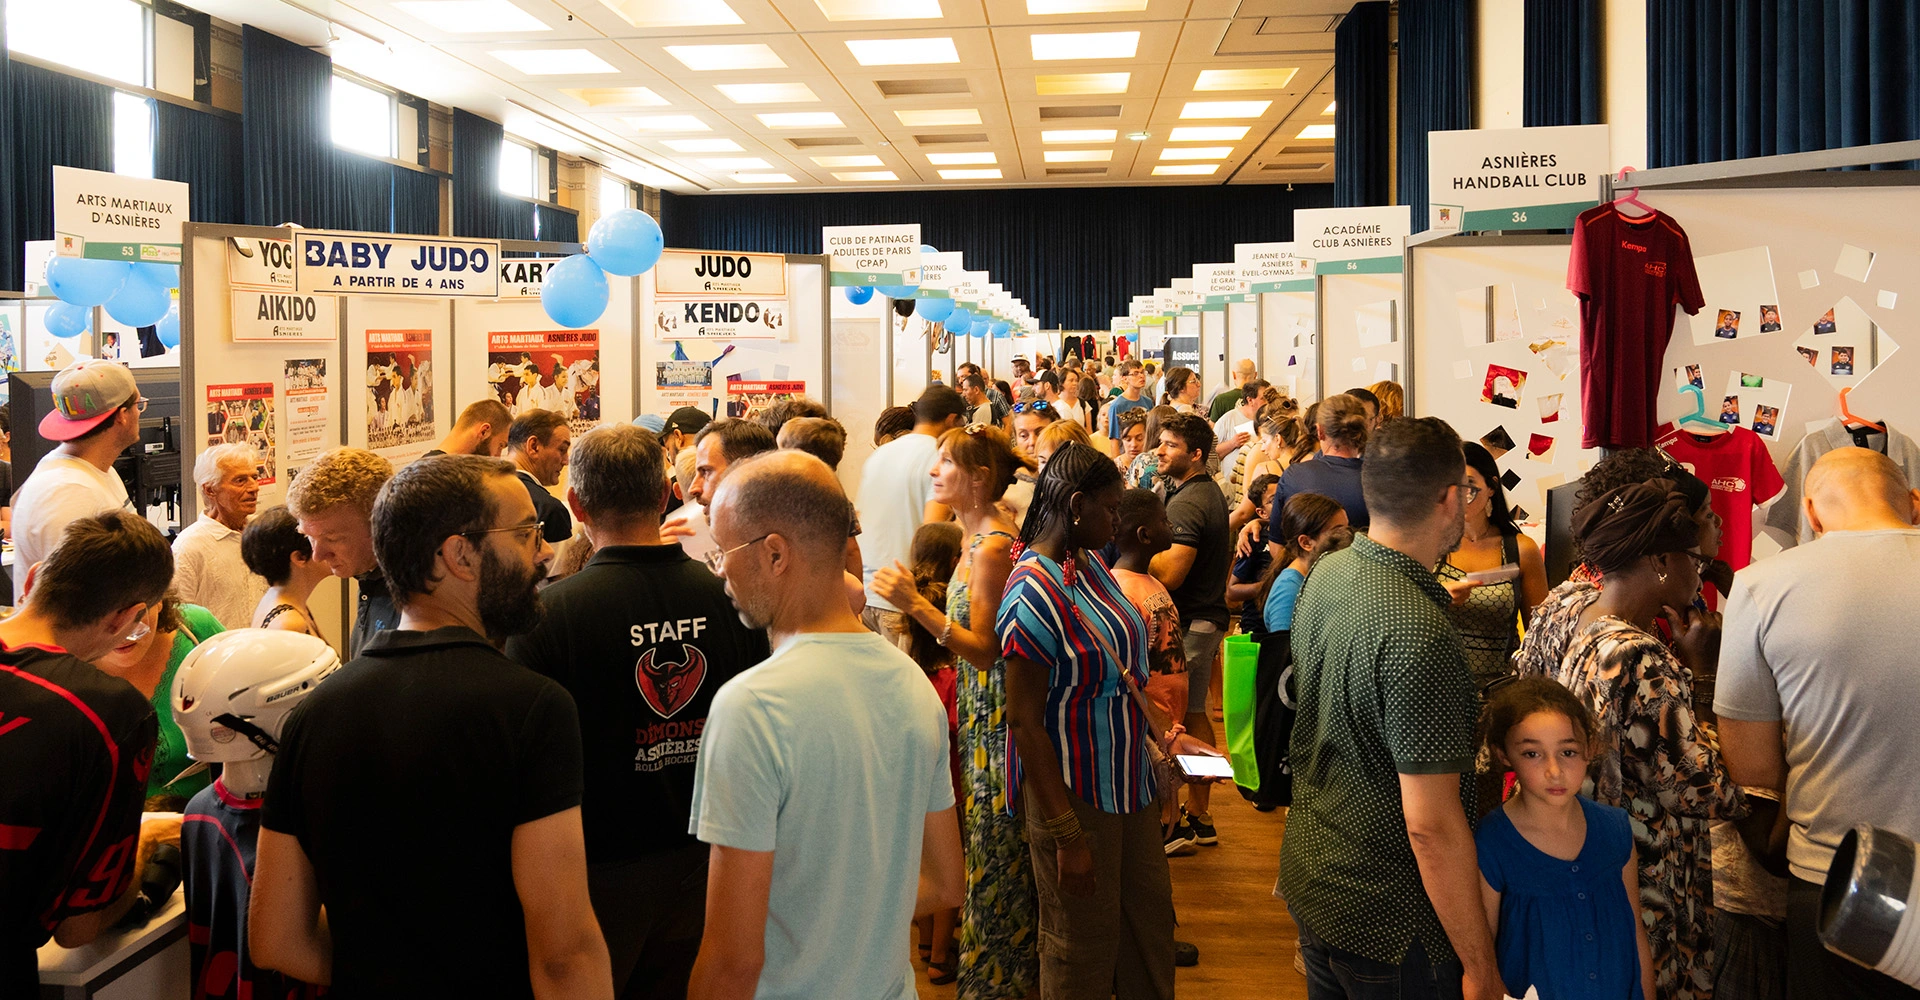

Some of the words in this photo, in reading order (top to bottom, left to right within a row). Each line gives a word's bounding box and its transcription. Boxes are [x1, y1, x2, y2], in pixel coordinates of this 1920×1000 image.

[1481, 152, 1557, 169] ASNIÈRES
[1453, 174, 1539, 189] HANDBALL
[1545, 173, 1587, 186] CLUB
[76, 193, 107, 207] ARTS
[111, 197, 173, 215] MARTIAUX
[92, 212, 161, 229] D'ASNIÈRES
[1512, 212, 1527, 223] 36
[1323, 223, 1381, 235] ACADÉMIE
[829, 236, 853, 245] CLUB
[855, 236, 867, 244] DE
[869, 234, 914, 244] PATINAGE
[1312, 239, 1340, 248] CLUB
[1342, 236, 1392, 248] ASNIÈRES
[121, 246, 134, 256] 53
[832, 247, 869, 257] ADULTES
[872, 247, 884, 256] DE
[886, 246, 912, 255] PARIS
[1621, 240, 1647, 253] Kempa
[305, 240, 392, 269] BABY
[411, 245, 489, 273] JUDO
[1252, 252, 1279, 260] JEANNE
[695, 255, 751, 278] JUDO
[856, 258, 888, 269] (CPAP)
[1261, 260, 1294, 268] ASNIÈRES
[1346, 262, 1357, 270] 56
[501, 263, 554, 283] KAR
[1242, 268, 1294, 277] ÉVEIL-GYMNAS
[333, 275, 342, 286] A
[350, 275, 395, 288] PARTIR
[402, 277, 419, 288] DE
[425, 278, 432, 288] 4
[439, 278, 465, 290] ANS
[867, 275, 877, 283] 52
[257, 294, 316, 322] AIKIDO
[684, 302, 760, 323] KENDO
[491, 334, 509, 344] ARTS
[509, 333, 545, 344] MARTIAUX
[1711, 478, 1735, 488] AHC
[630, 616, 707, 647] STAFF
[266, 685, 300, 703] BAUER
